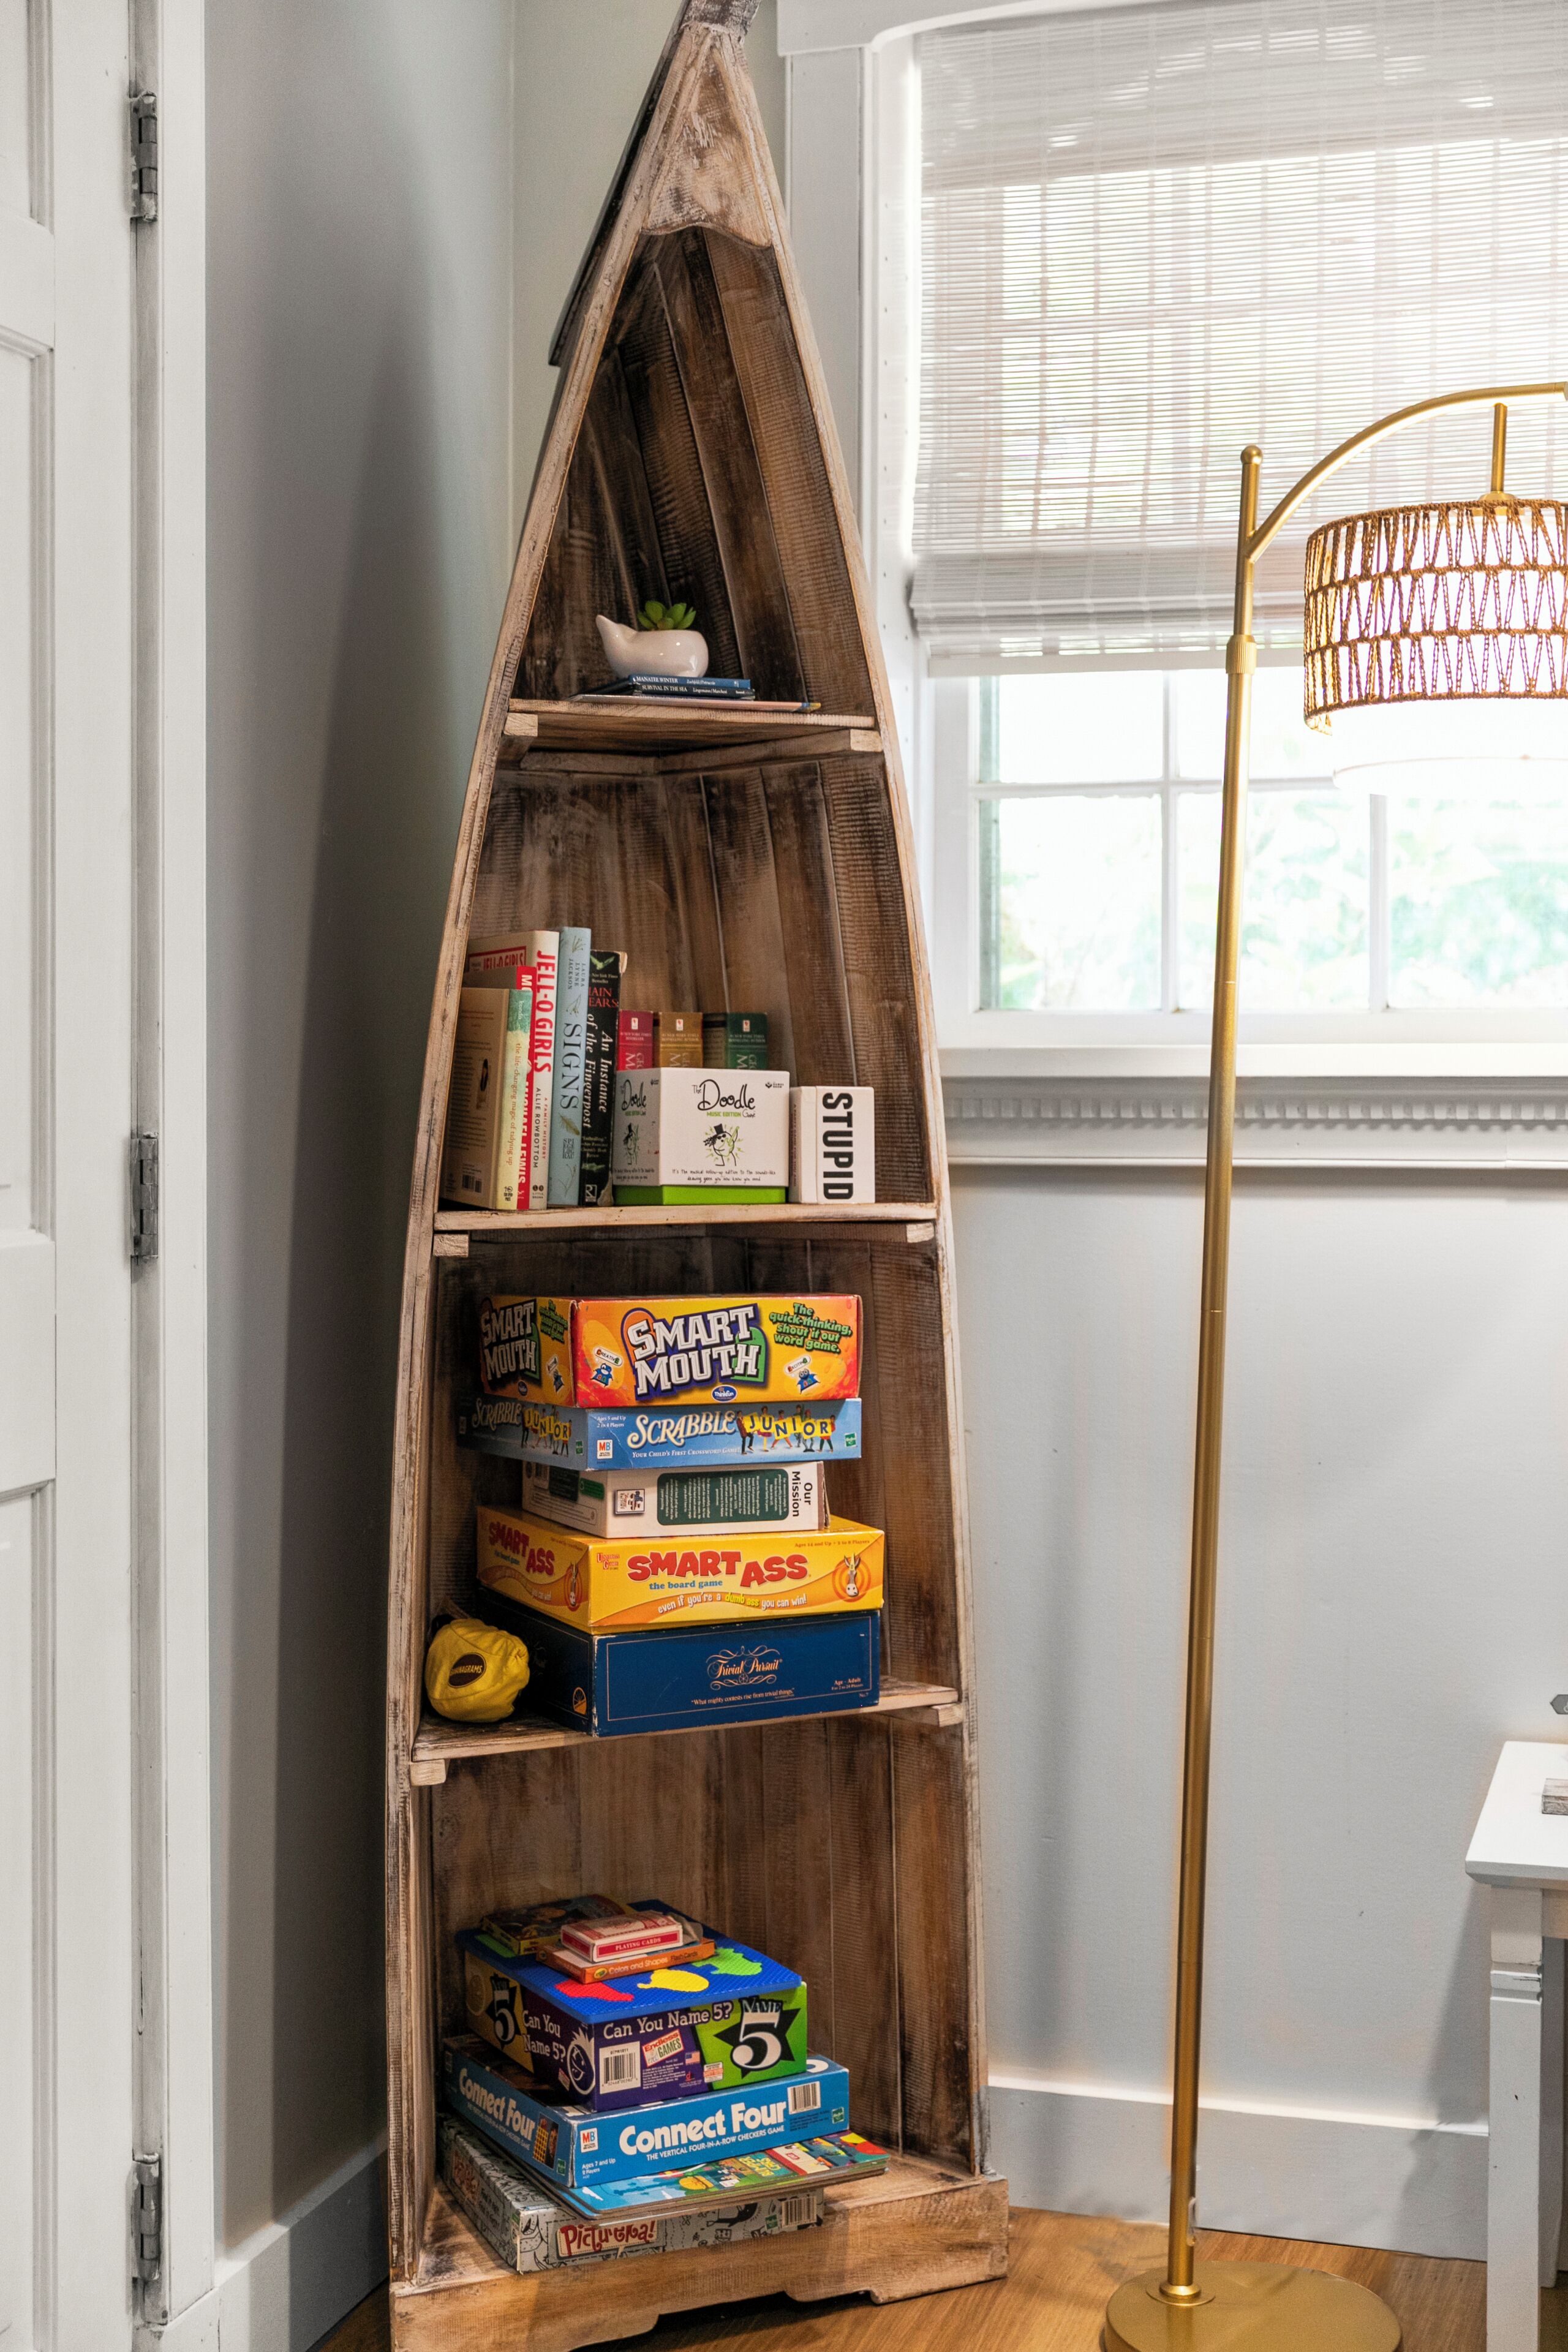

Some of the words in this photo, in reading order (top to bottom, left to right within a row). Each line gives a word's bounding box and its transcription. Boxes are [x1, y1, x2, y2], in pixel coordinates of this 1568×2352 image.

[536, 950, 556, 1013] JELL-O
[589, 987, 611, 997] IAIN
[589, 998, 618, 1008] EARS
[587, 1014, 598, 1030] of
[533, 1018, 553, 1073] GIRLS
[586, 1033, 598, 1053] the
[601, 1031, 613, 1052] An
[511, 1056, 521, 1099] life-changing
[560, 1022, 581, 1109] SIGNS
[583, 1059, 595, 1128] Fingerpost
[598, 1060, 612, 1113] Instance
[622, 1079, 646, 1110] Doodle
[692, 1085, 701, 1094] The
[697, 1079, 755, 1110] Doodle
[510, 1122, 516, 1131] of
[507, 1131, 516, 1155] tidying
[823, 1093, 854, 1199] STUPID
[506, 1156, 512, 1166] up
[793, 1303, 813, 1316] The
[481, 1302, 535, 1347] SMART
[627, 1306, 754, 1360] SMART
[769, 1311, 853, 1336] quick-thinking,
[777, 1323, 809, 1336] shout
[811, 1327, 820, 1339] it
[821, 1332, 840, 1342] out
[774, 1334, 804, 1346] word
[805, 1340, 840, 1352] game.
[484, 1339, 537, 1381] MOUTH
[596, 1349, 620, 1365] CREATIVE
[634, 1343, 760, 1396] MOUTH
[472, 1398, 522, 1431] SCRABBLE
[526, 1410, 568, 1438] JUNIOR
[627, 1410, 735, 1449] SCRABBLE
[750, 1415, 828, 1437] JUNIOR
[599, 1442, 610, 1450] MB
[793, 1471, 801, 1517] Mission
[804, 1482, 813, 1506] Our
[489, 1521, 530, 1557] SMART
[526, 1547, 555, 1576] ASS
[627, 1550, 741, 1581] SMART
[740, 1554, 808, 1588] ASS
[668, 1580, 696, 1589] board
[698, 1580, 723, 1589] game
[658, 1600, 676, 1615] even
[677, 1595, 685, 1607] if
[687, 1592, 713, 1607] you're
[725, 1593, 745, 1604] dumb
[747, 1598, 760, 1607] ass
[761, 1599, 775, 1611] you
[791, 1594, 807, 1606] win!
[712, 1659, 745, 1679] Trivial
[745, 1656, 780, 1674] Pursuit
[616, 1942, 641, 1950] PLAYING
[609, 1965, 629, 1975] Colors
[644, 1958, 668, 1967] Shapes
[494, 1991, 515, 2042] 5
[742, 1999, 782, 2013] NAME
[522, 2010, 540, 2030] Can
[543, 2014, 561, 2038] You
[603, 2023, 632, 2039] Can
[637, 2018, 663, 2034] You
[668, 2009, 709, 2029] Name
[713, 2002, 733, 2020] 5?
[523, 2035, 550, 2056] Name
[552, 2042, 566, 2062] 5?
[644, 2032, 679, 2052] Endless
[658, 2038, 682, 2058] GAMES
[733, 2011, 782, 2069] 5
[459, 2068, 506, 2122] Connect
[506, 2098, 535, 2141] Four
[582, 2132, 595, 2143] MB
[619, 2109, 726, 2155] Connect
[731, 2101, 788, 2133] Four
[660, 2147, 687, 2158] VERTICAL
[689, 2138, 736, 2152] FOUR-IN-A-ROW
[737, 2130, 766, 2141] CHECKERS
[767, 2125, 785, 2134] GAME
